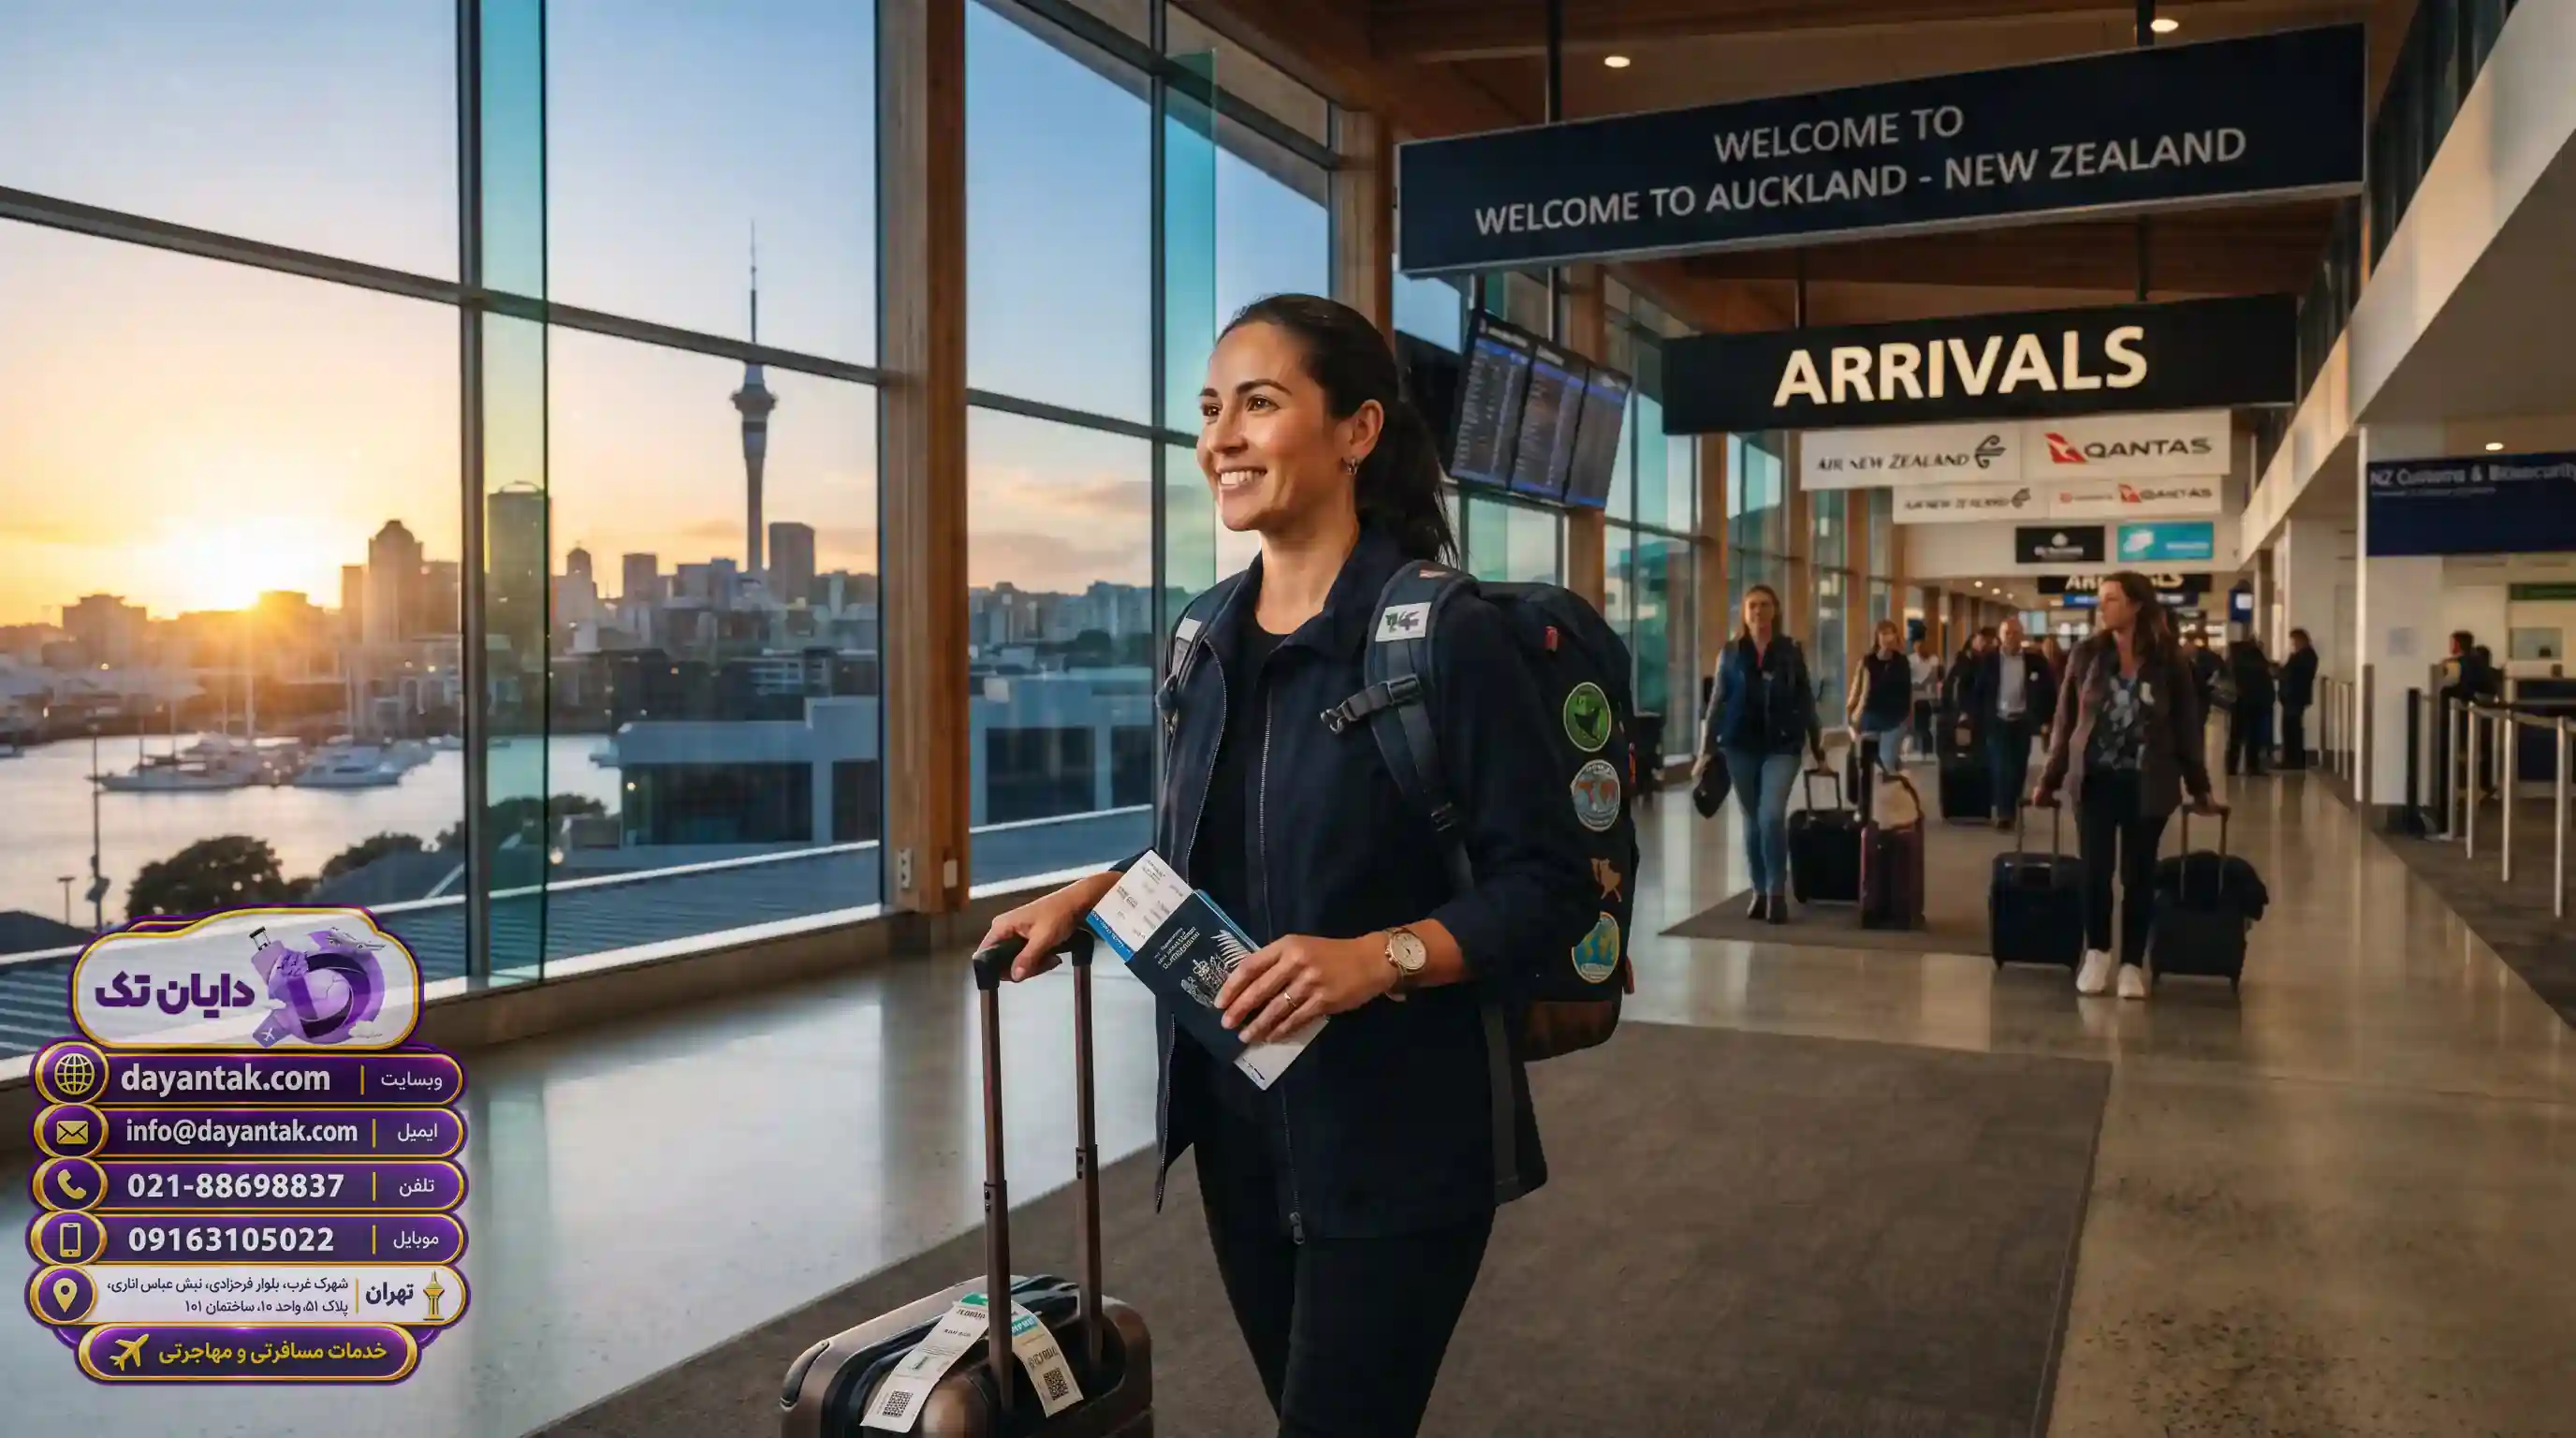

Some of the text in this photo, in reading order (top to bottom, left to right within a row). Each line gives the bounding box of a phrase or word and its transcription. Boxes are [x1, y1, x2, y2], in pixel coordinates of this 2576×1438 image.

[1714, 105, 1964, 163] WELCOME TO
[1475, 192, 1639, 236] WELCOME
[1649, 186, 1695, 217] TO
[1705, 165, 1907, 213] AUCKLAND
[1945, 149, 2039, 190] NEW
[2050, 127, 2247, 179] ZEALAND
[1773, 326, 2147, 406] ARRIVALS
[1888, 452, 1969, 470] ZEALAND
[2085, 437, 2213, 459] QANTAS
[2370, 469, 2394, 485] NZ
